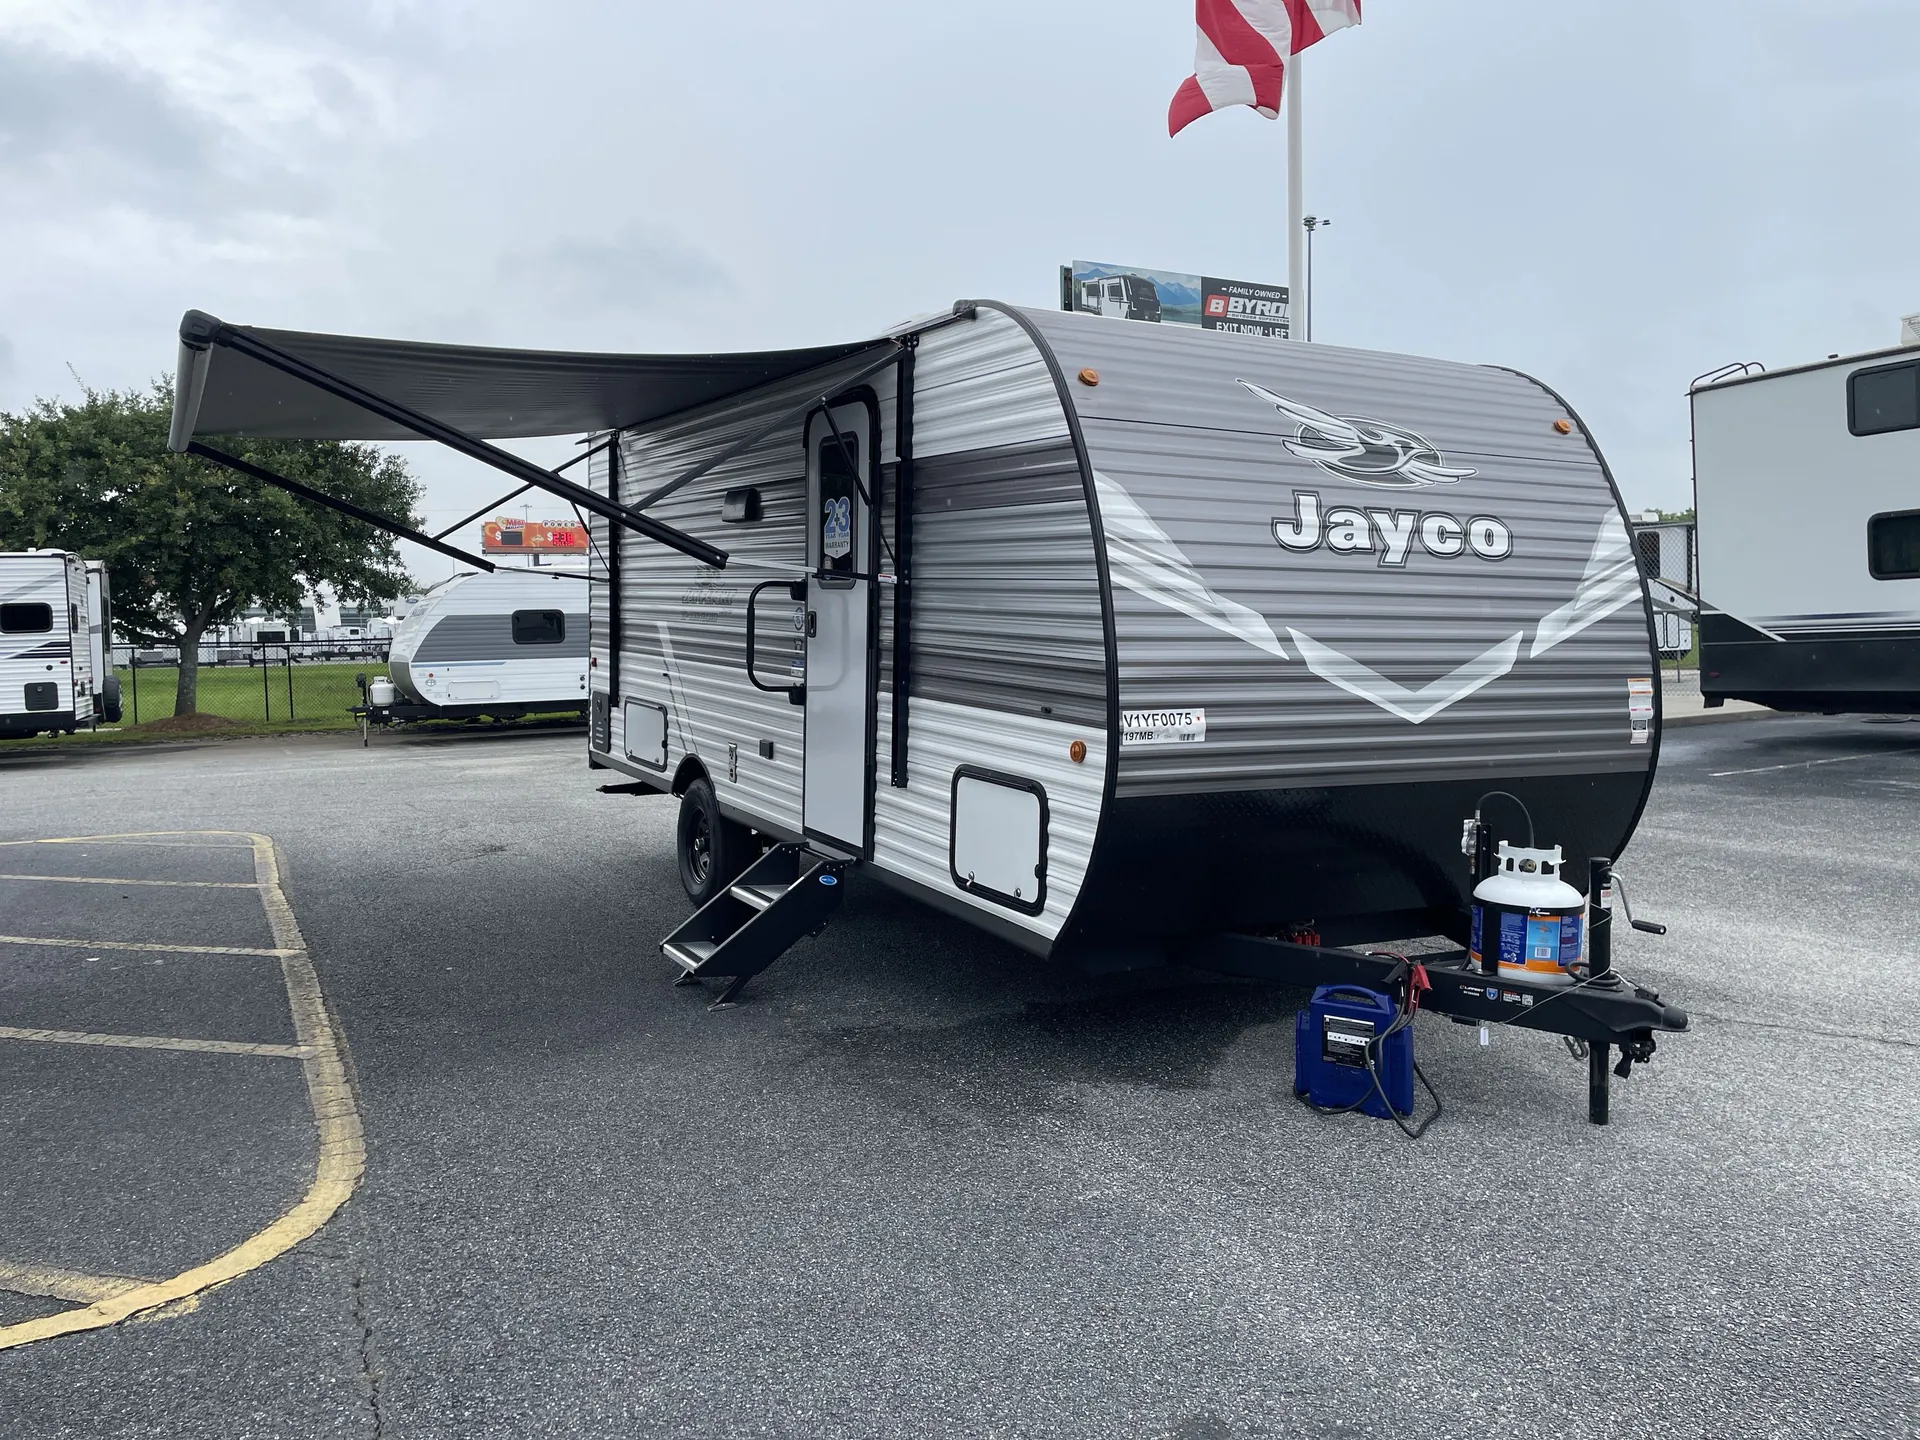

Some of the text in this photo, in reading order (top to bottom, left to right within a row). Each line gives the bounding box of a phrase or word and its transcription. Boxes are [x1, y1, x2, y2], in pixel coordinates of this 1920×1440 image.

[1228, 286, 1281, 299] FAMILY OWNED
[1216, 321, 1239, 333] EXIT
[1240, 324, 1263, 337] NOW
[1271, 489, 1513, 568] Jayco
[825, 541, 850, 549] WARRANTY
[1123, 712, 1192, 727] V1YF0075
[1124, 732, 1154, 741] 197MB
